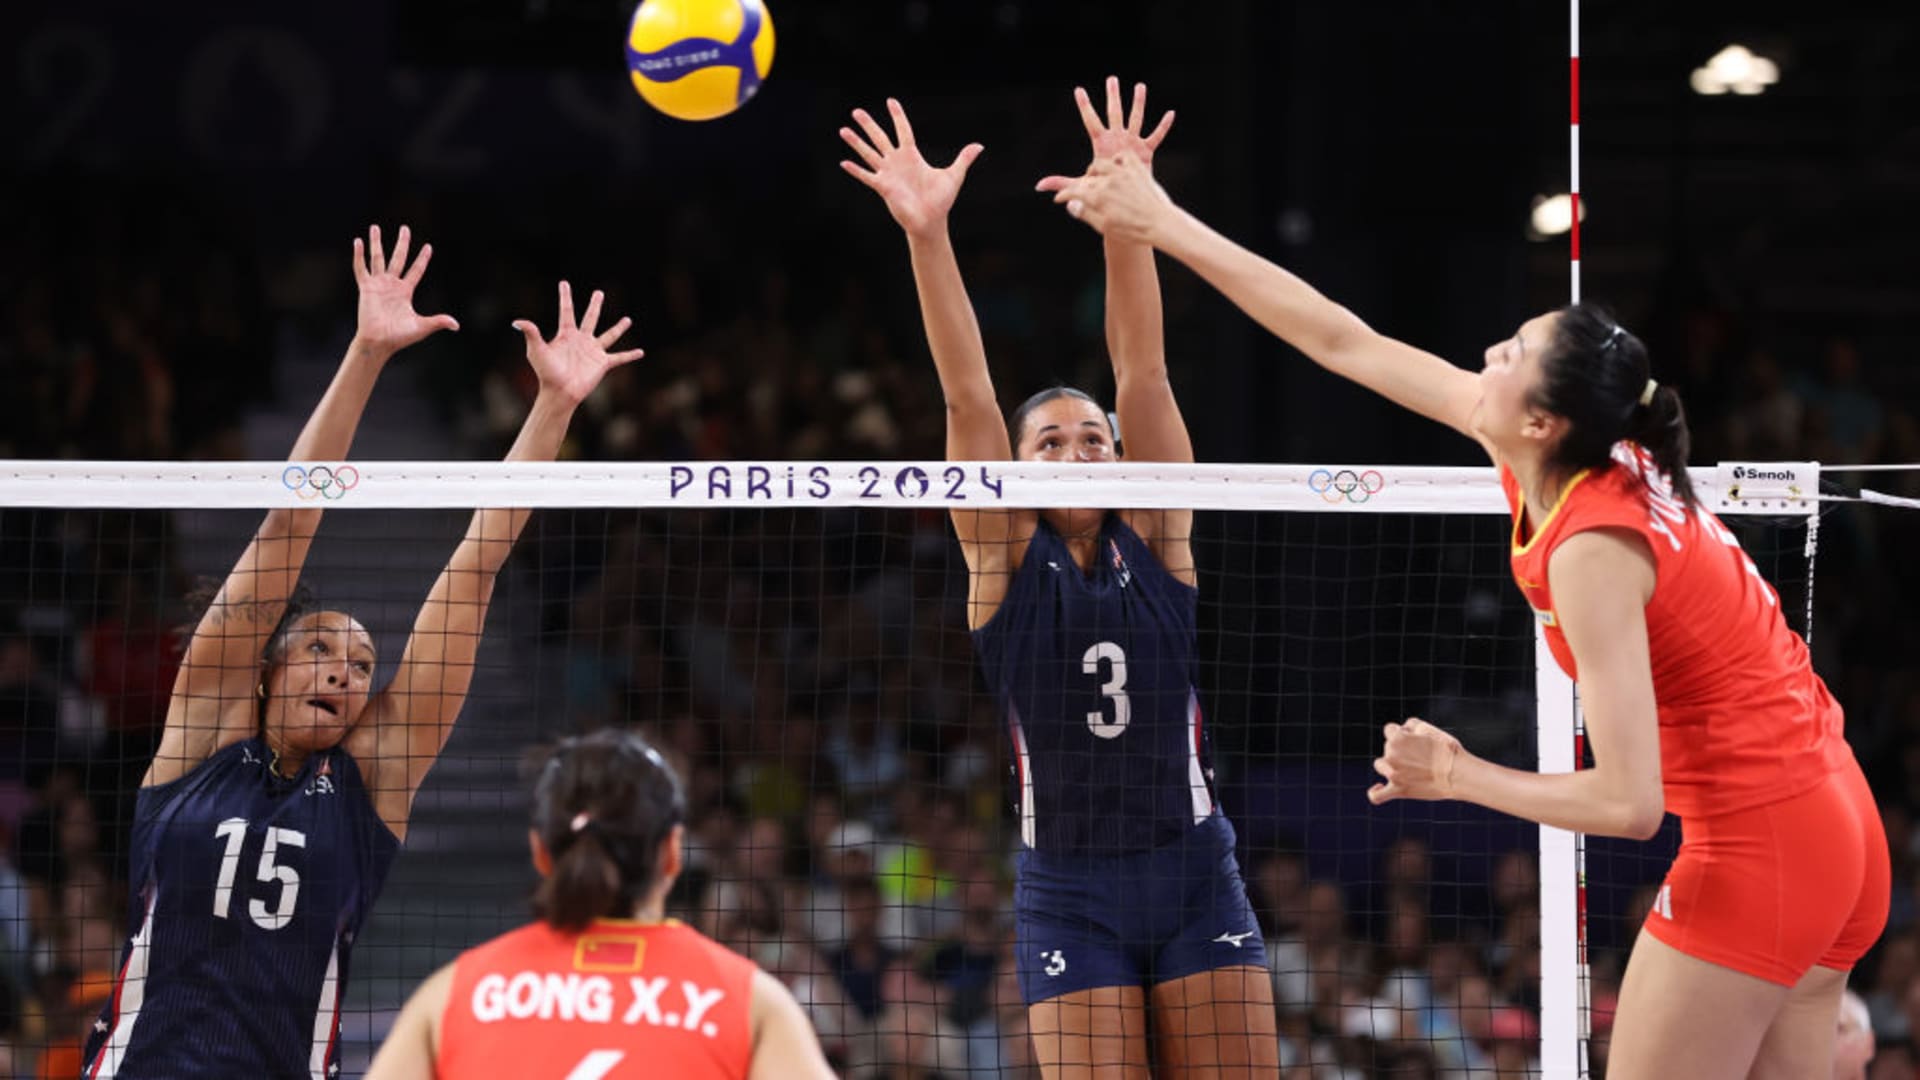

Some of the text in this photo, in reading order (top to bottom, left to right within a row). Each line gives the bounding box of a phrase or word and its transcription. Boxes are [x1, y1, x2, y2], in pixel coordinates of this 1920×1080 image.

[857, 466, 1002, 499] 2024
[1746, 468, 1795, 481] Senoh
[1082, 641, 1131, 739] 3
[213, 817, 306, 930] 15
[1040, 950, 1066, 976] 3
[471, 971, 725, 1037] GONG X.Y.
